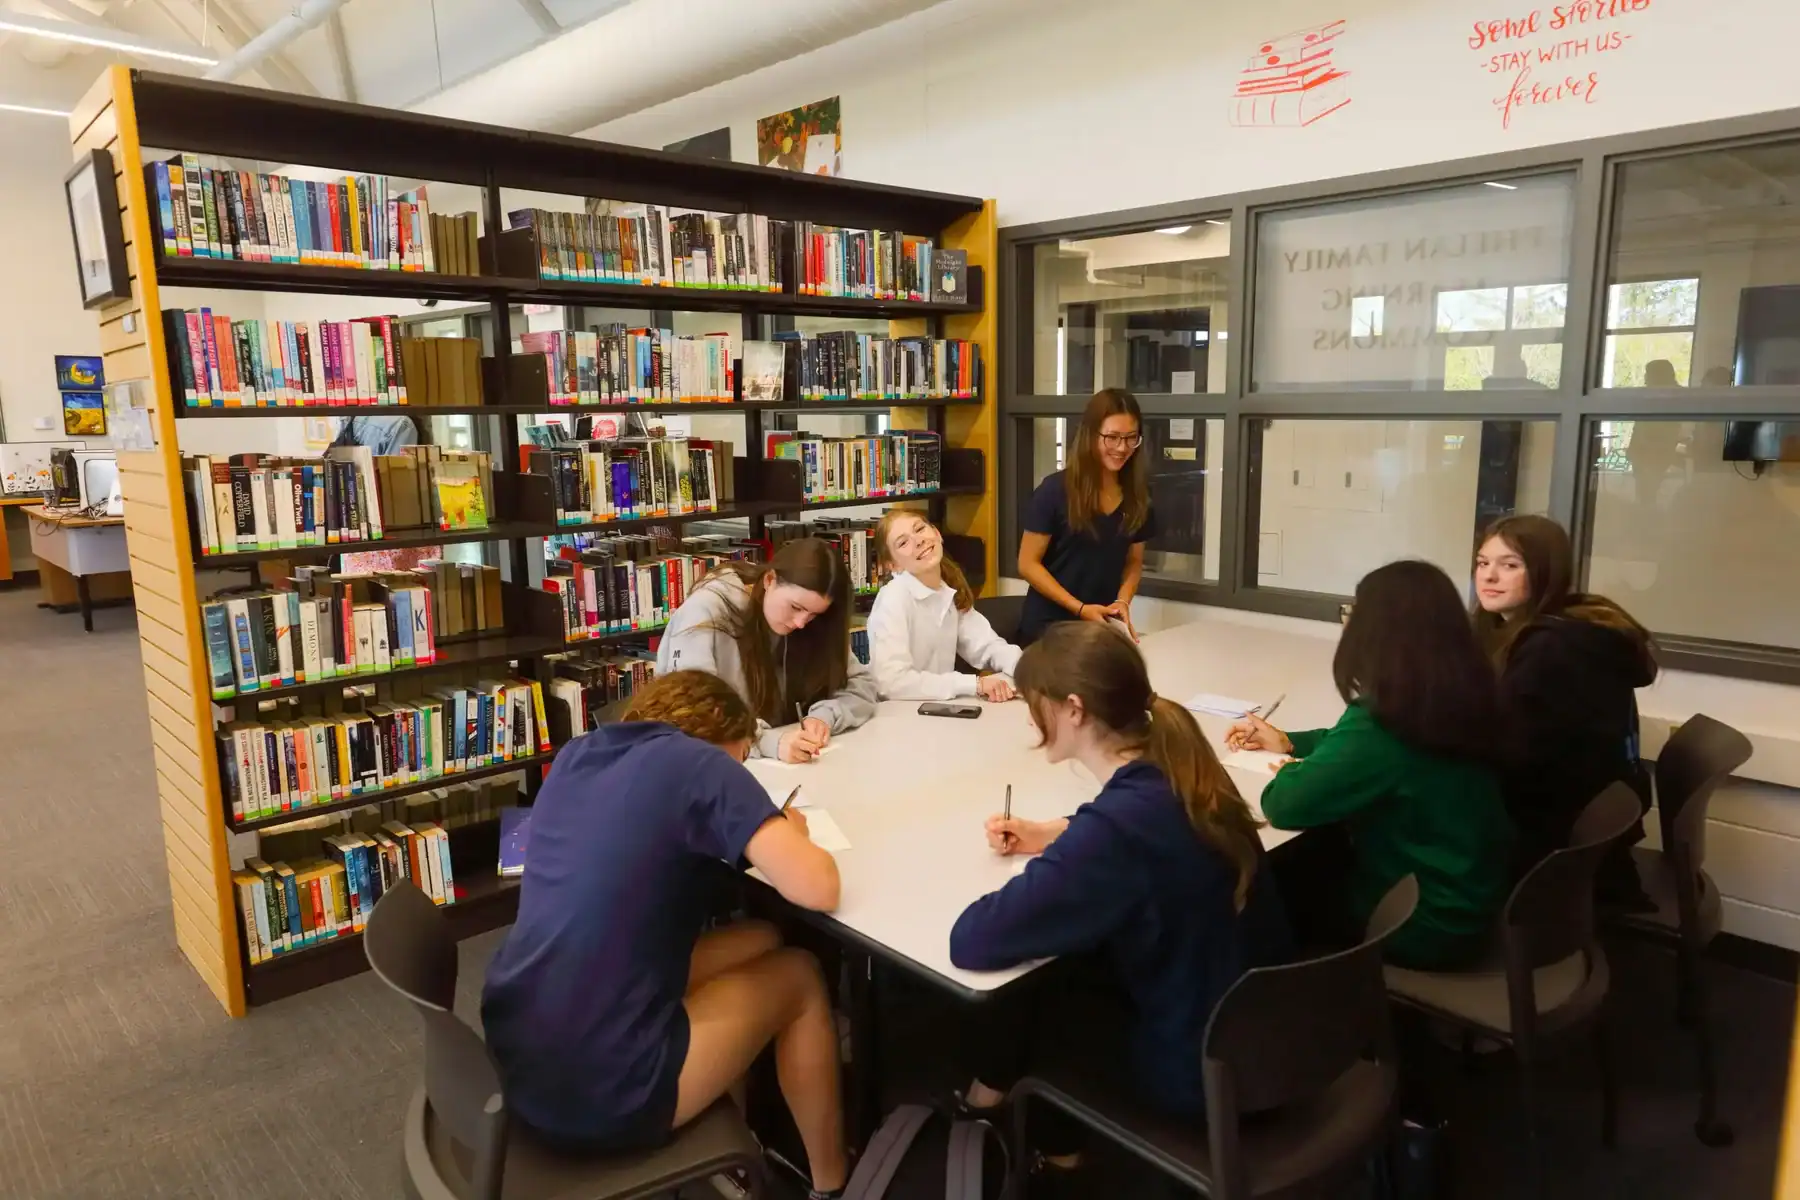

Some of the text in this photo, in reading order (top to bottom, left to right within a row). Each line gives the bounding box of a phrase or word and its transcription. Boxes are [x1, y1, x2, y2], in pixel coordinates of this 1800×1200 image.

[1538, 38, 1588, 63] WITH
[1492, 66, 1598, 129] forever
[234, 481, 245, 527] COPPERFIELD
[242, 492, 251, 515] DAVID
[293, 483, 302, 505] Oliver
[262, 605, 274, 635] AKIN
[414, 608, 425, 631] K
[244, 767, 253, 795] WASHINGTON
[258, 764, 266, 791] WASHINGTON
